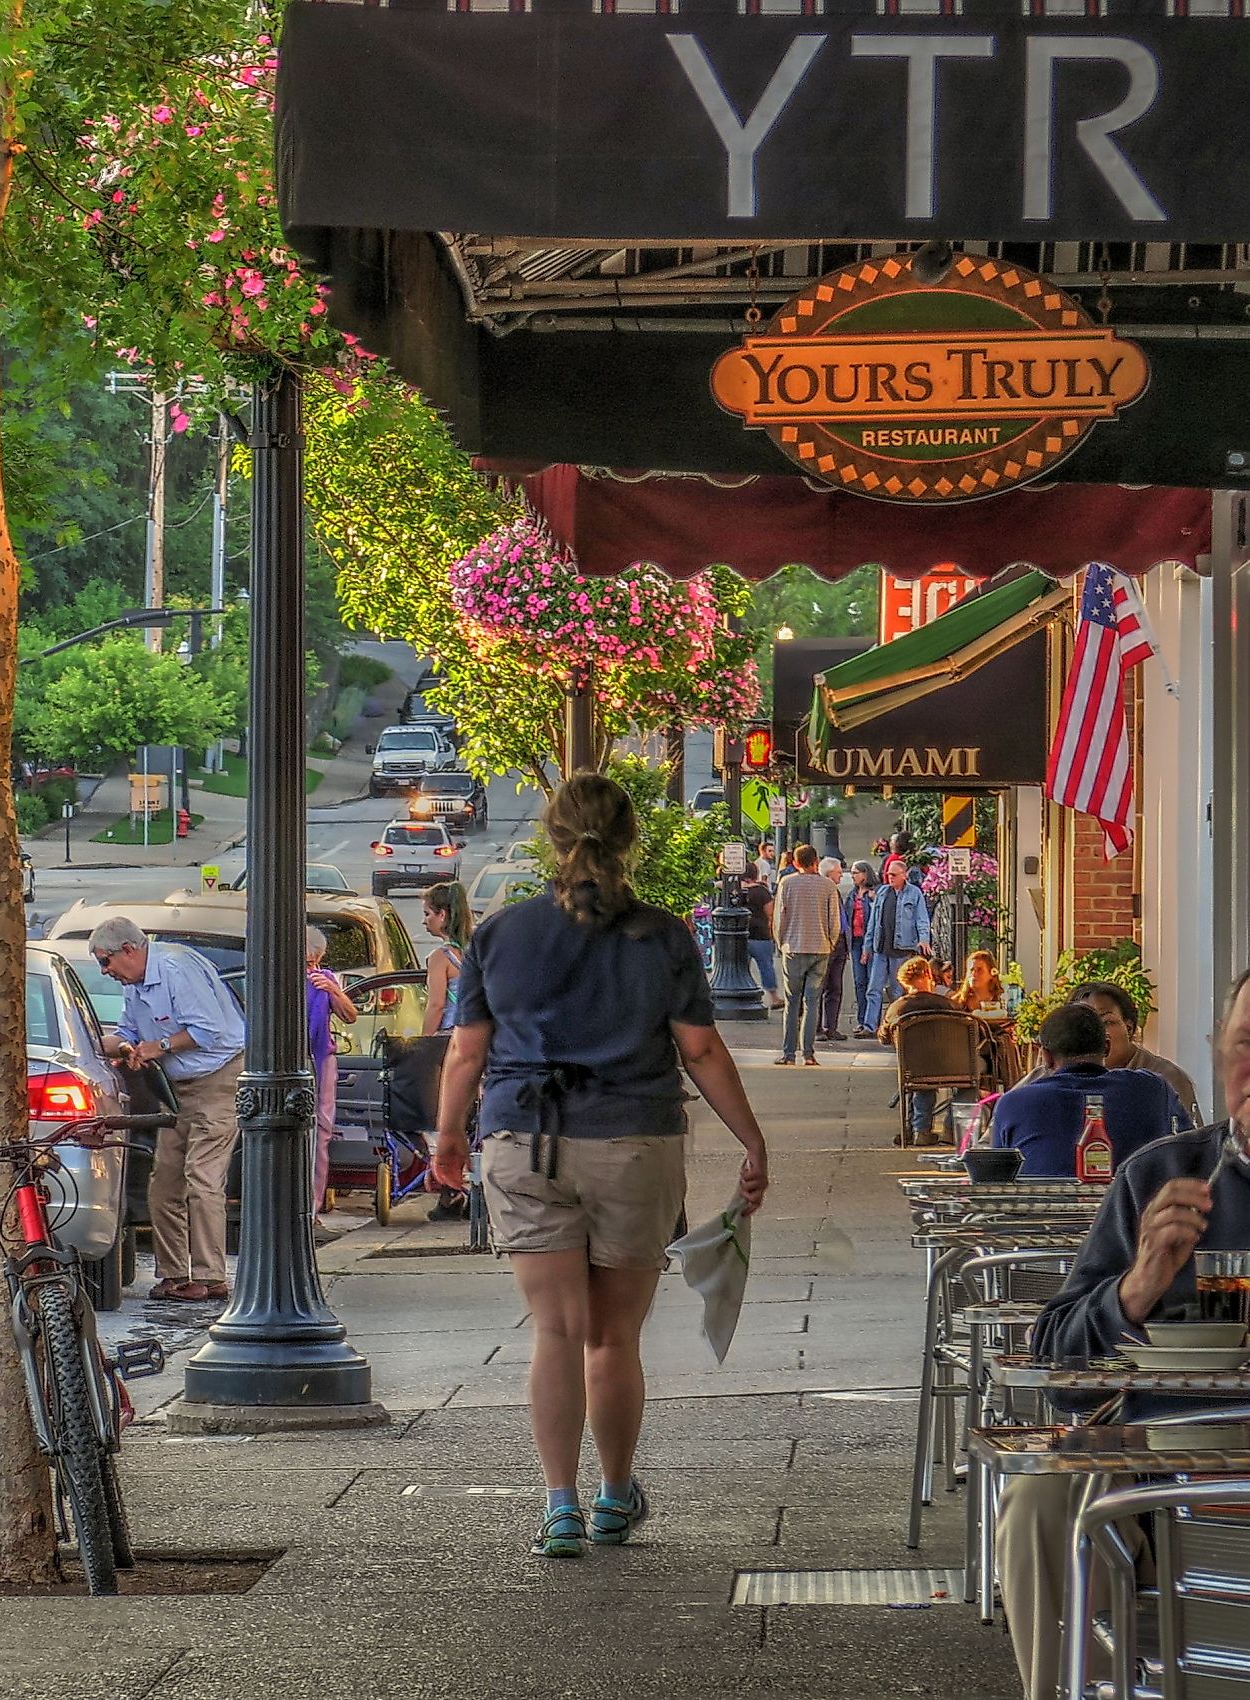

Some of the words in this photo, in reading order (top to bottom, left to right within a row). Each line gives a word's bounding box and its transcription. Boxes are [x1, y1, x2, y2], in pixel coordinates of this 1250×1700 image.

[666, 33, 1168, 221] YTR
[742, 353, 934, 405] YOURS
[946, 348, 1124, 400] TRULY
[862, 427, 1001, 447] RESTAURANT
[827, 748, 980, 777] UMAMI
